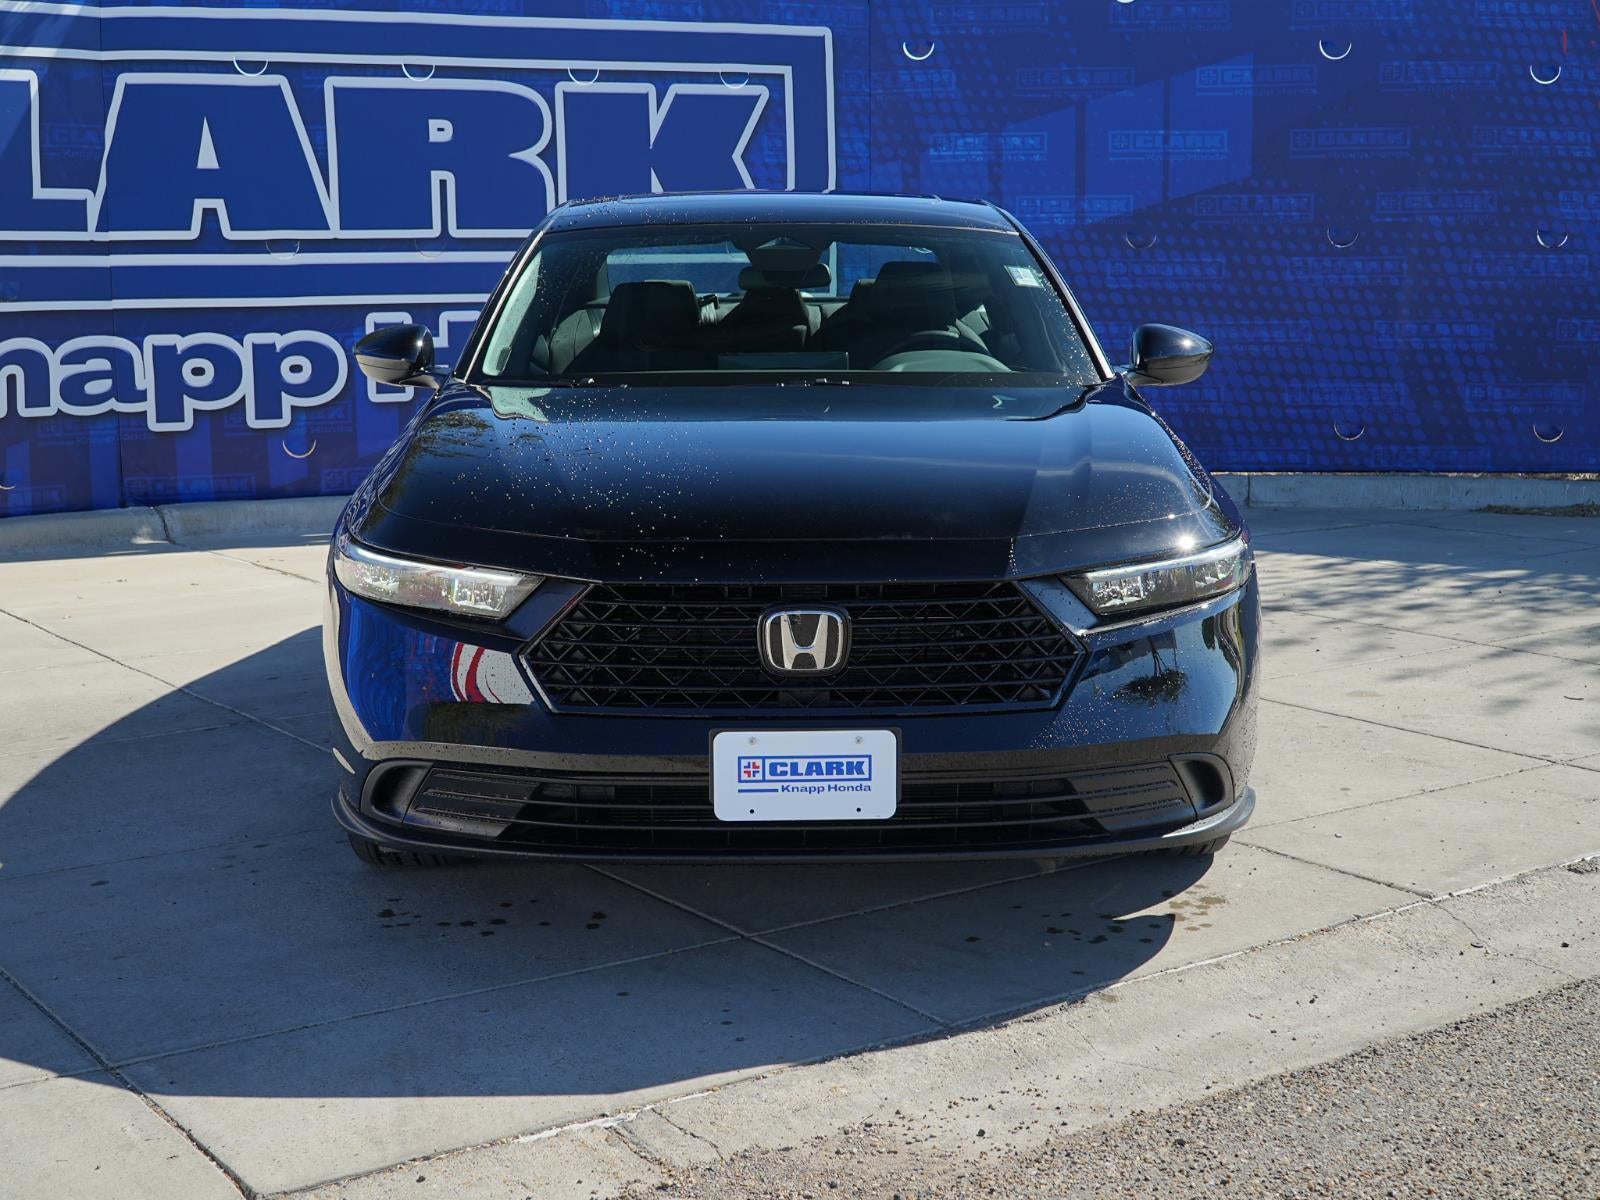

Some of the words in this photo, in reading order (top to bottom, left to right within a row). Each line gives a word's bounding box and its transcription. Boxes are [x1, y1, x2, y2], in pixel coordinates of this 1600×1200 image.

[769, 760, 865, 777] CLARK
[781, 784, 825, 795] Knapp
[828, 783, 871, 792] Honda
